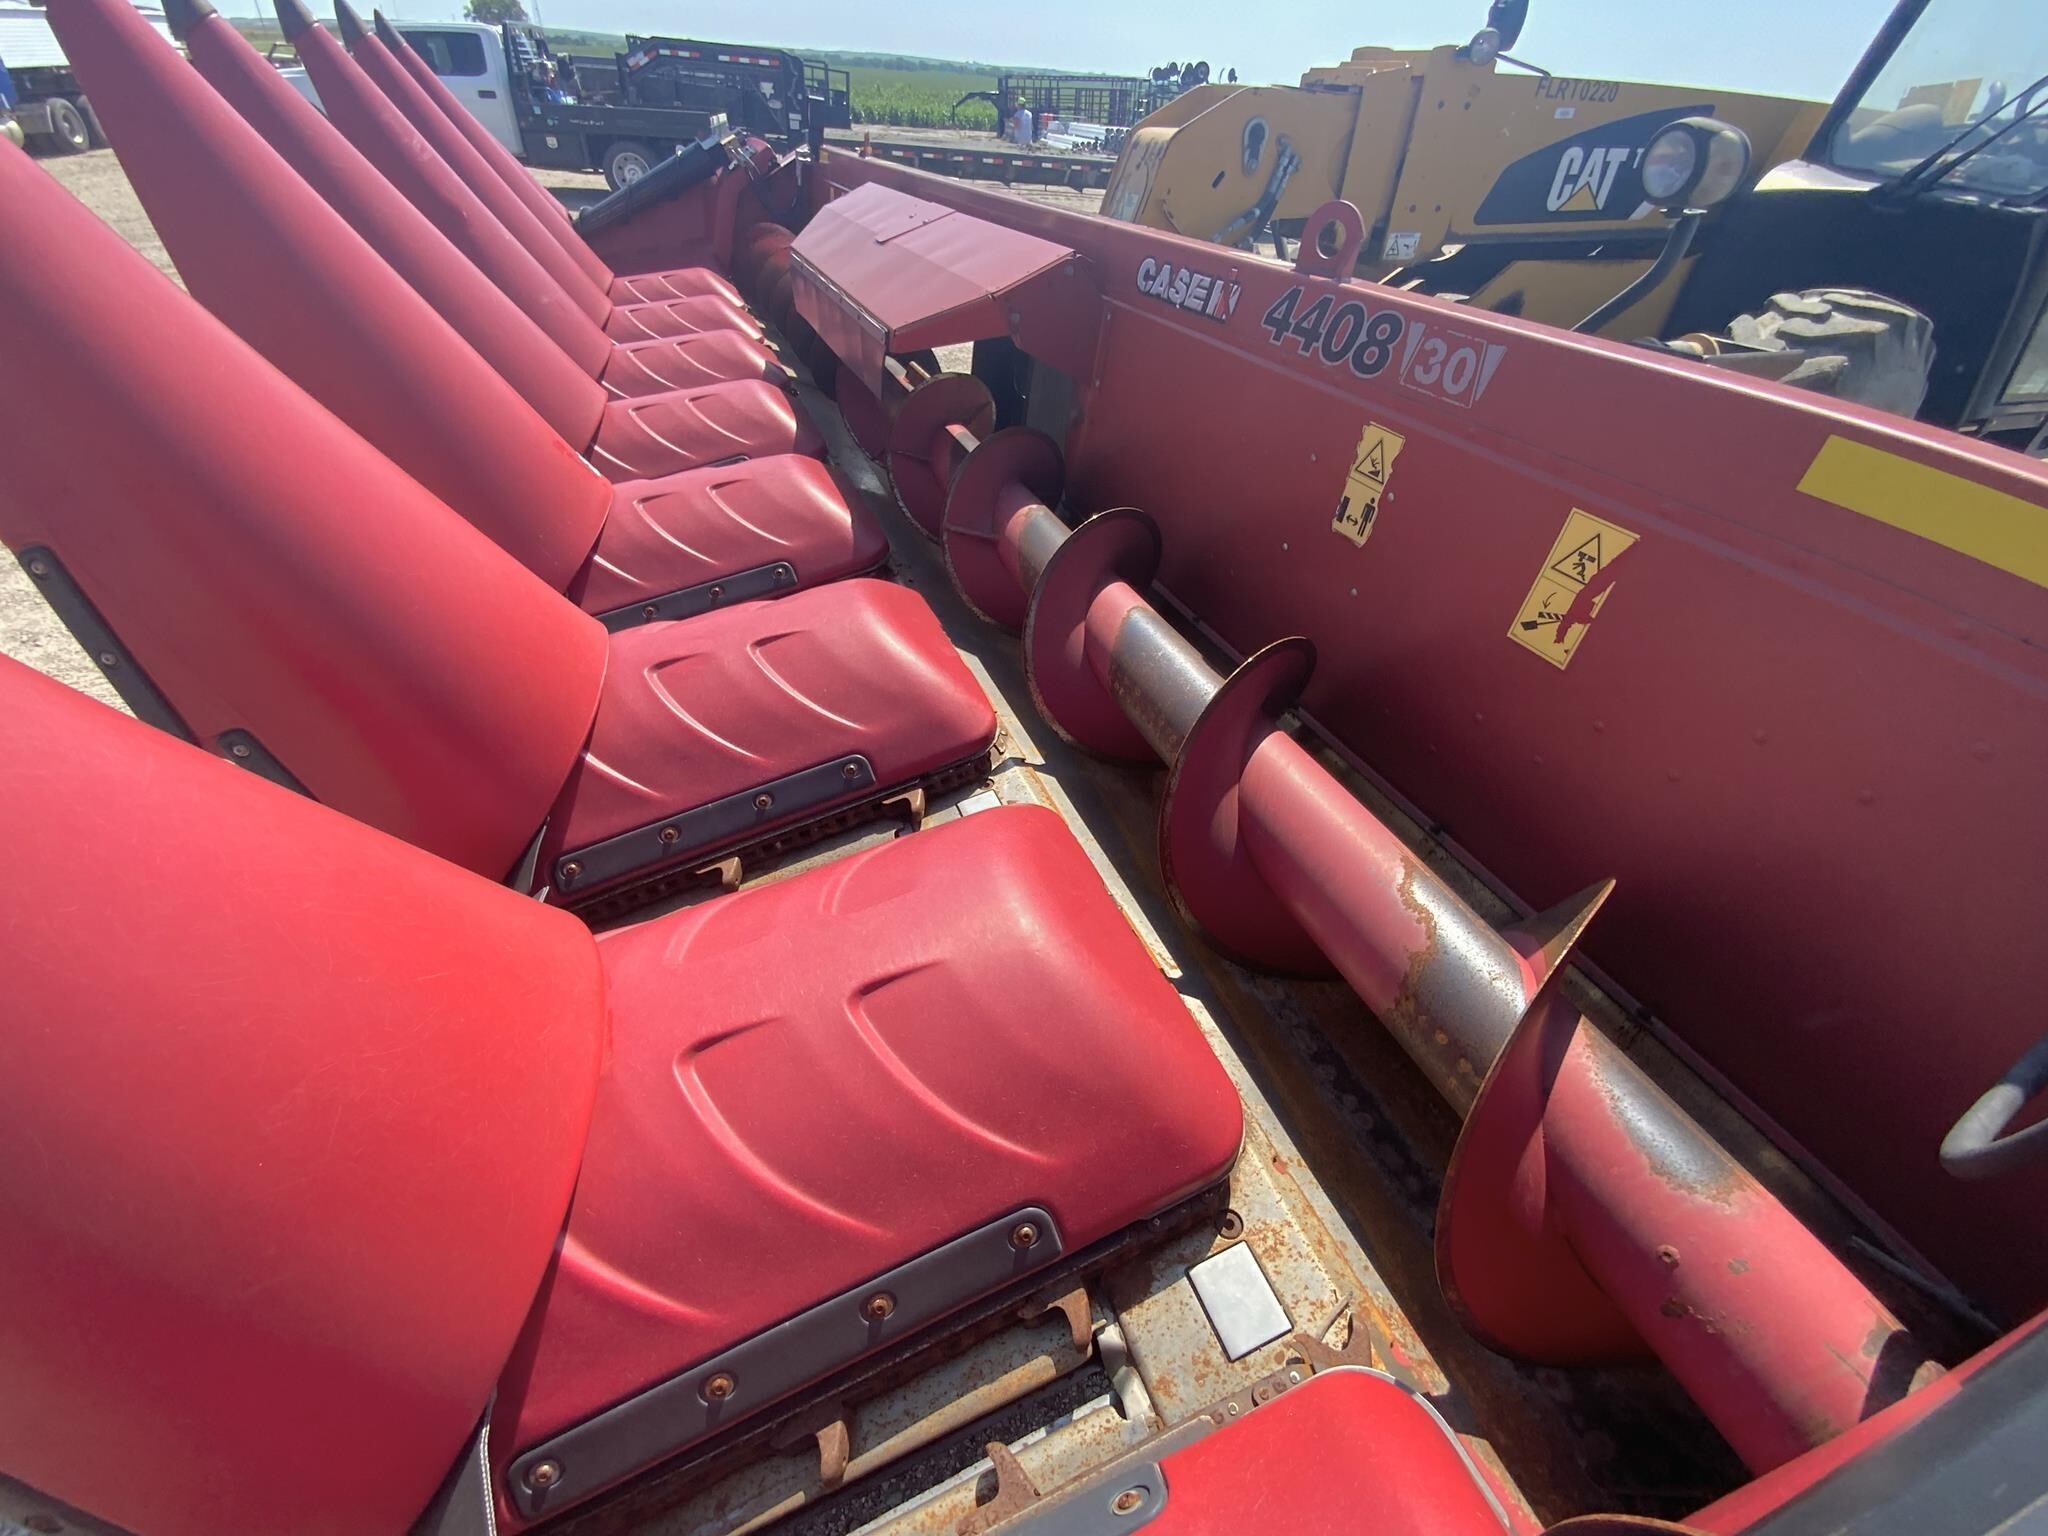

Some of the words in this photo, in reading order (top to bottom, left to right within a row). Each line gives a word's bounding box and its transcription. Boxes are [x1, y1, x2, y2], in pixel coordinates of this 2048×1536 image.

[1547, 147, 1630, 212] CAT
[1261, 285, 1405, 379] 4408
[1414, 338, 1477, 395] 30
